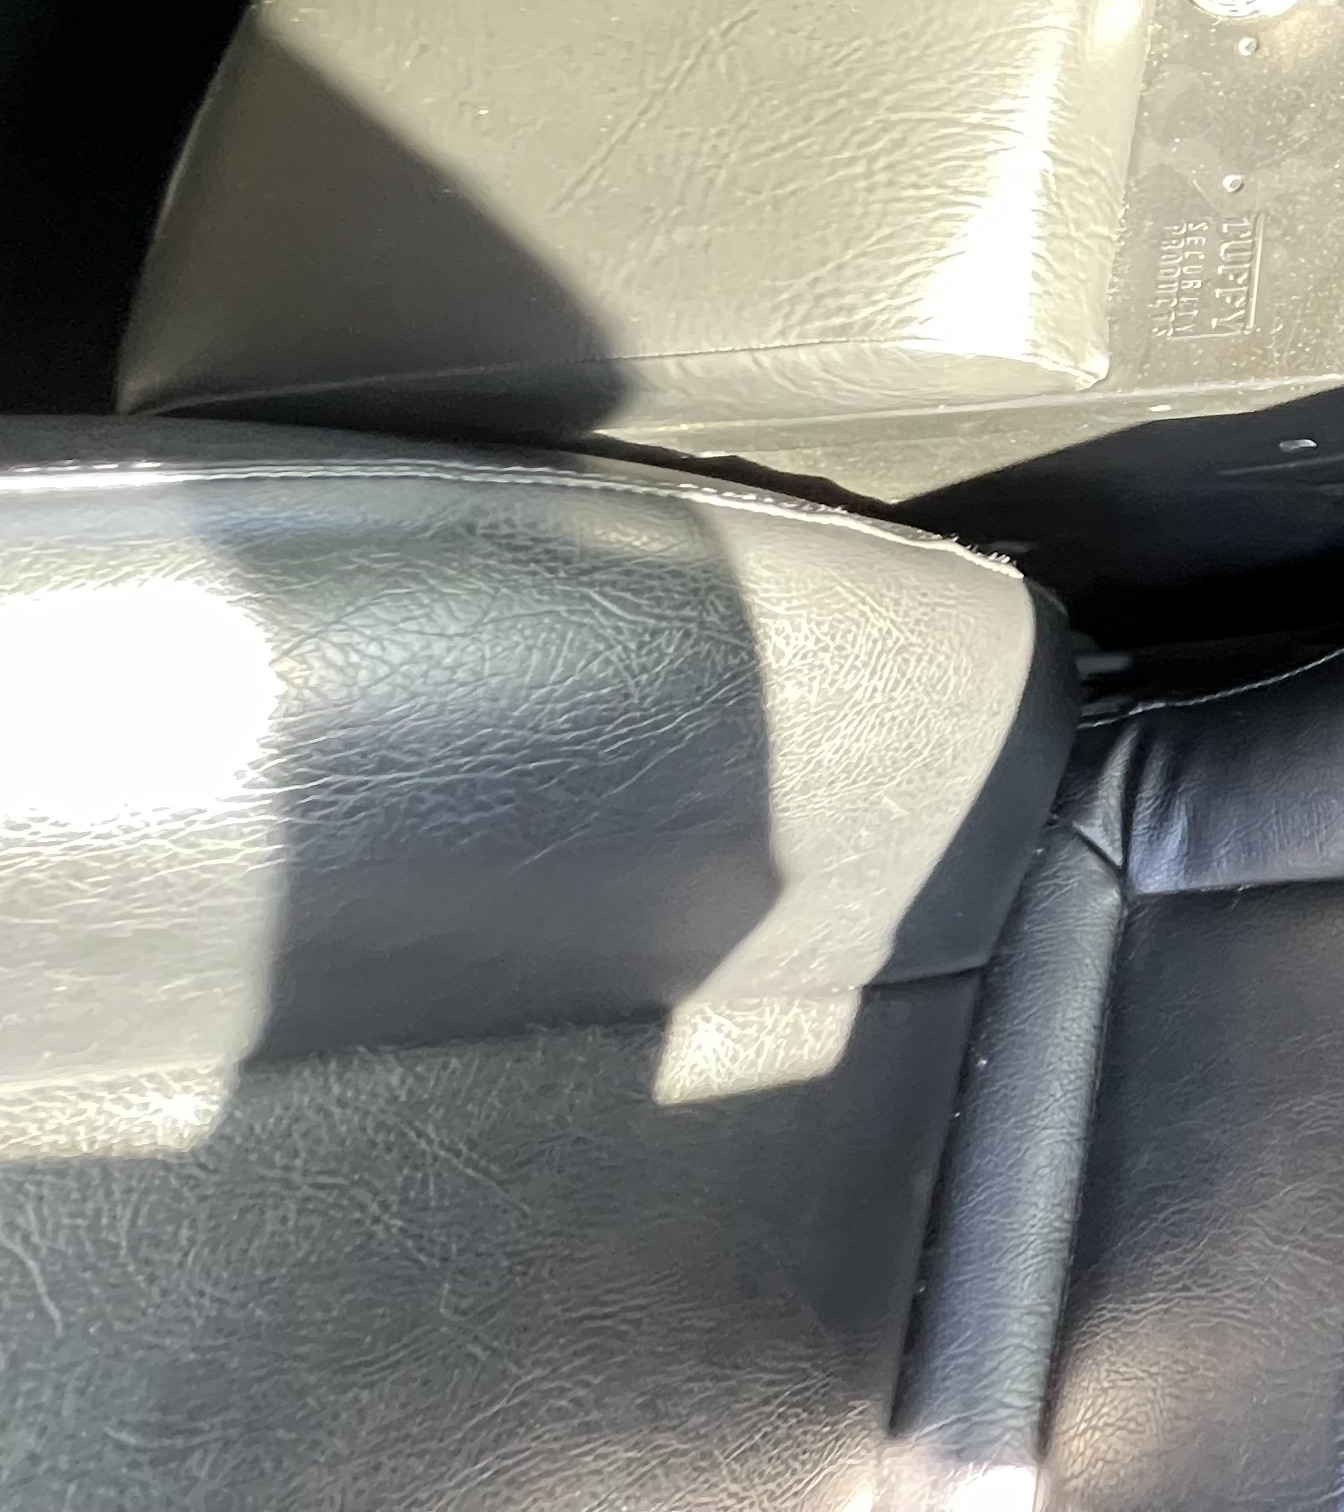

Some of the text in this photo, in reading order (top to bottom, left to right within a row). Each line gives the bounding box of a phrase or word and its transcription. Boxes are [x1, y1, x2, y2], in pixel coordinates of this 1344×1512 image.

[1148, 221, 1187, 336] PRODUCTS
[1175, 222, 1209, 332] SECURITY
[1210, 217, 1252, 330] TUFFY
